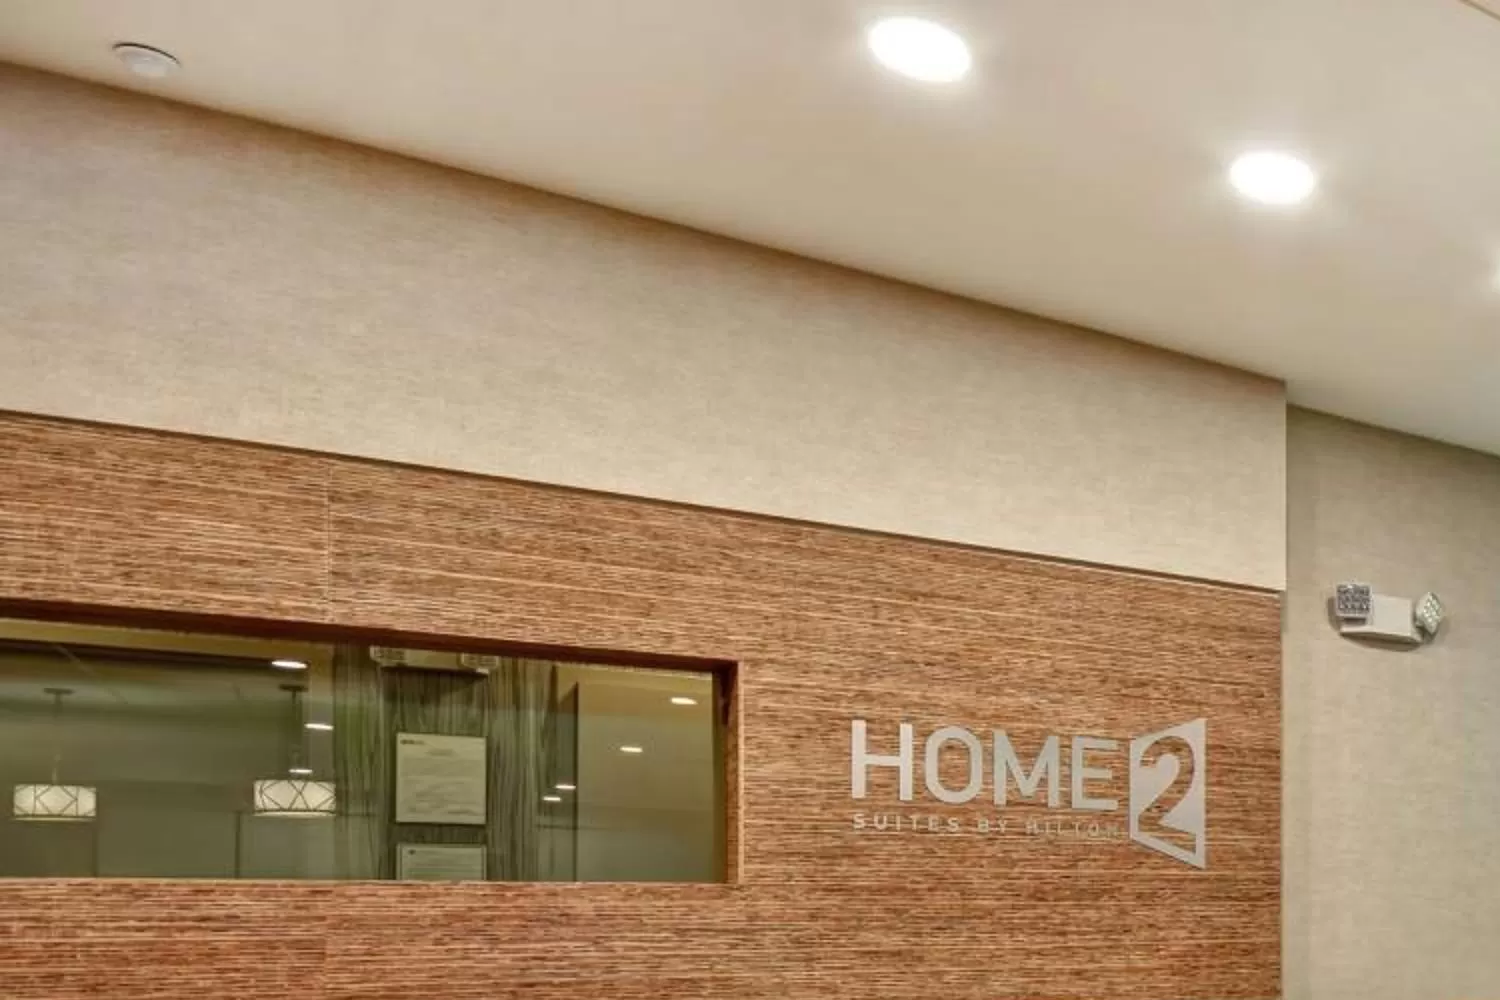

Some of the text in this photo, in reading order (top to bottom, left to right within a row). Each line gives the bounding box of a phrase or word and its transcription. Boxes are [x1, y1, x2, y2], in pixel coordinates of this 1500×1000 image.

[852, 812, 1122, 840] SUITES BY HILTON
